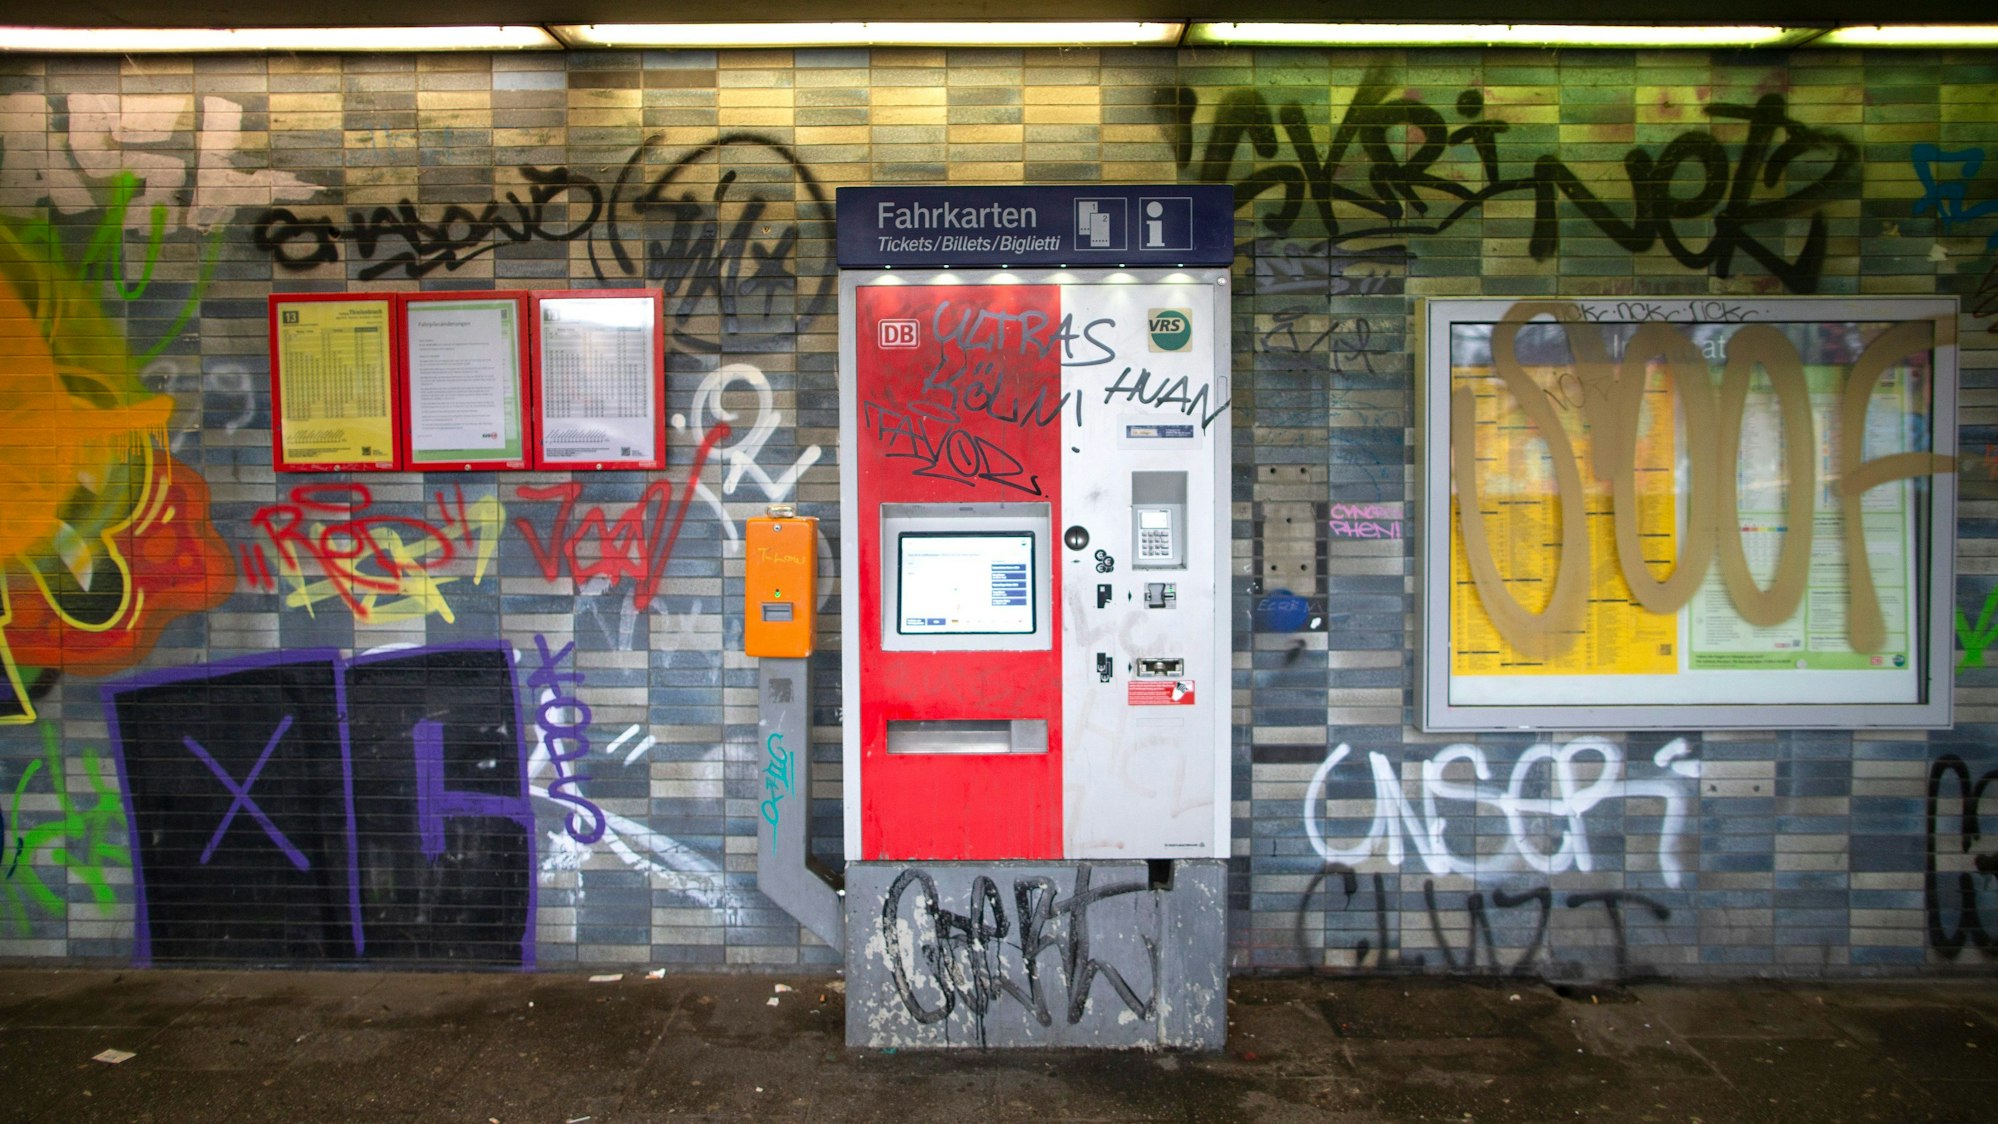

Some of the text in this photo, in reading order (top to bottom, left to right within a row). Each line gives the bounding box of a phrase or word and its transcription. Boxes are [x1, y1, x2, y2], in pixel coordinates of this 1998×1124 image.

[877, 202, 1037, 229] Fahrkarten
[285, 313, 297, 322] 13
[1149, 319, 1181, 333] VRS
[883, 323, 915, 345] DB
[932, 300, 1117, 367] ULTRAS
